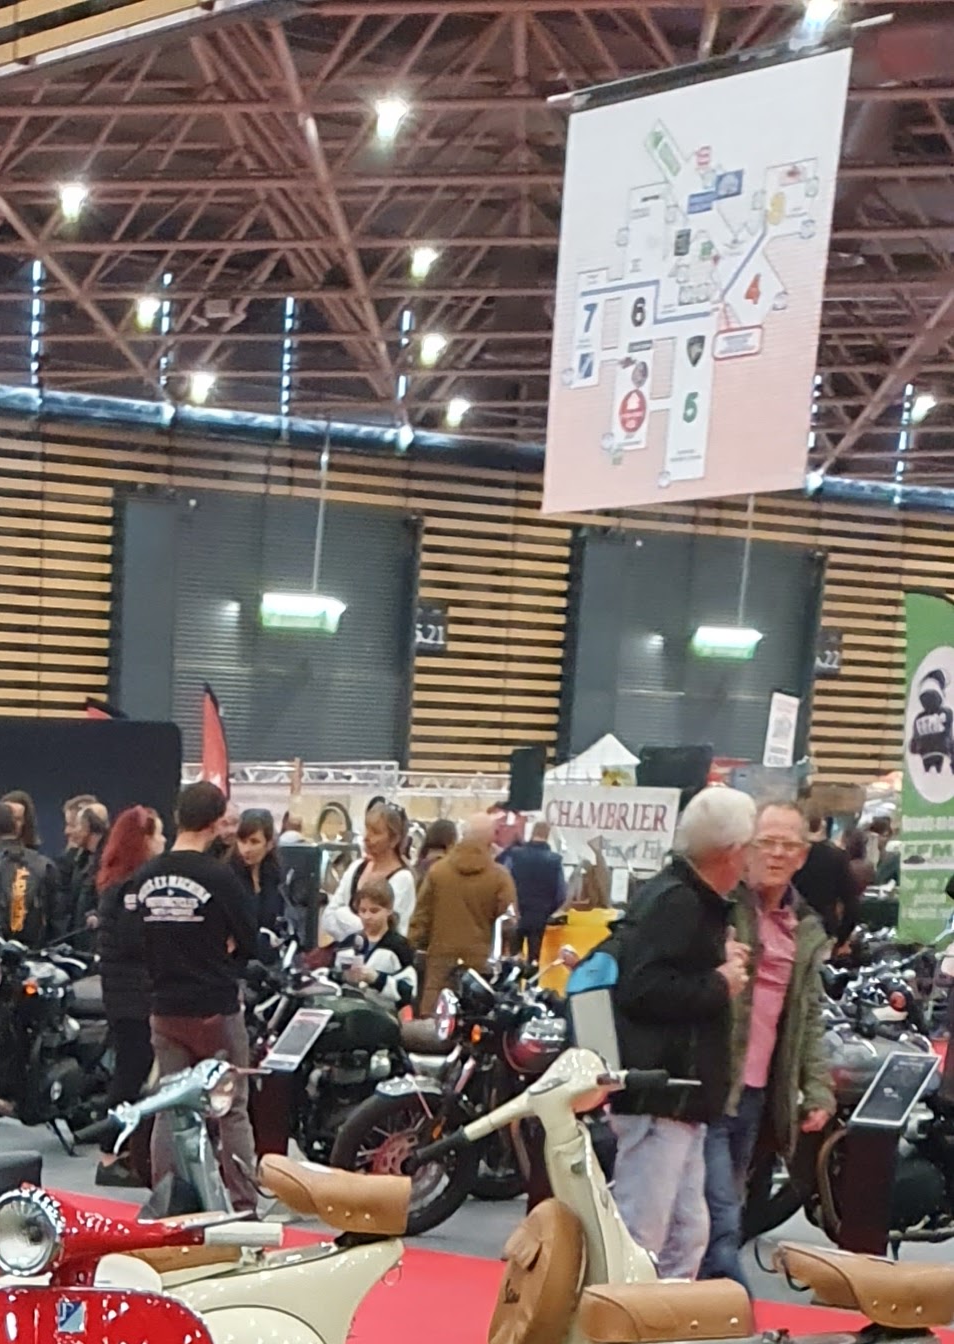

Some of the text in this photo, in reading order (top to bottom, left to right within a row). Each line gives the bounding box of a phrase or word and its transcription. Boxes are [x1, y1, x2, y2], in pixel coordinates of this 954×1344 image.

[744, 273, 761, 305] 4
[583, 303, 597, 333] 7
[631, 297, 646, 327] 6
[546, 799, 669, 833] CHAMBRIER
